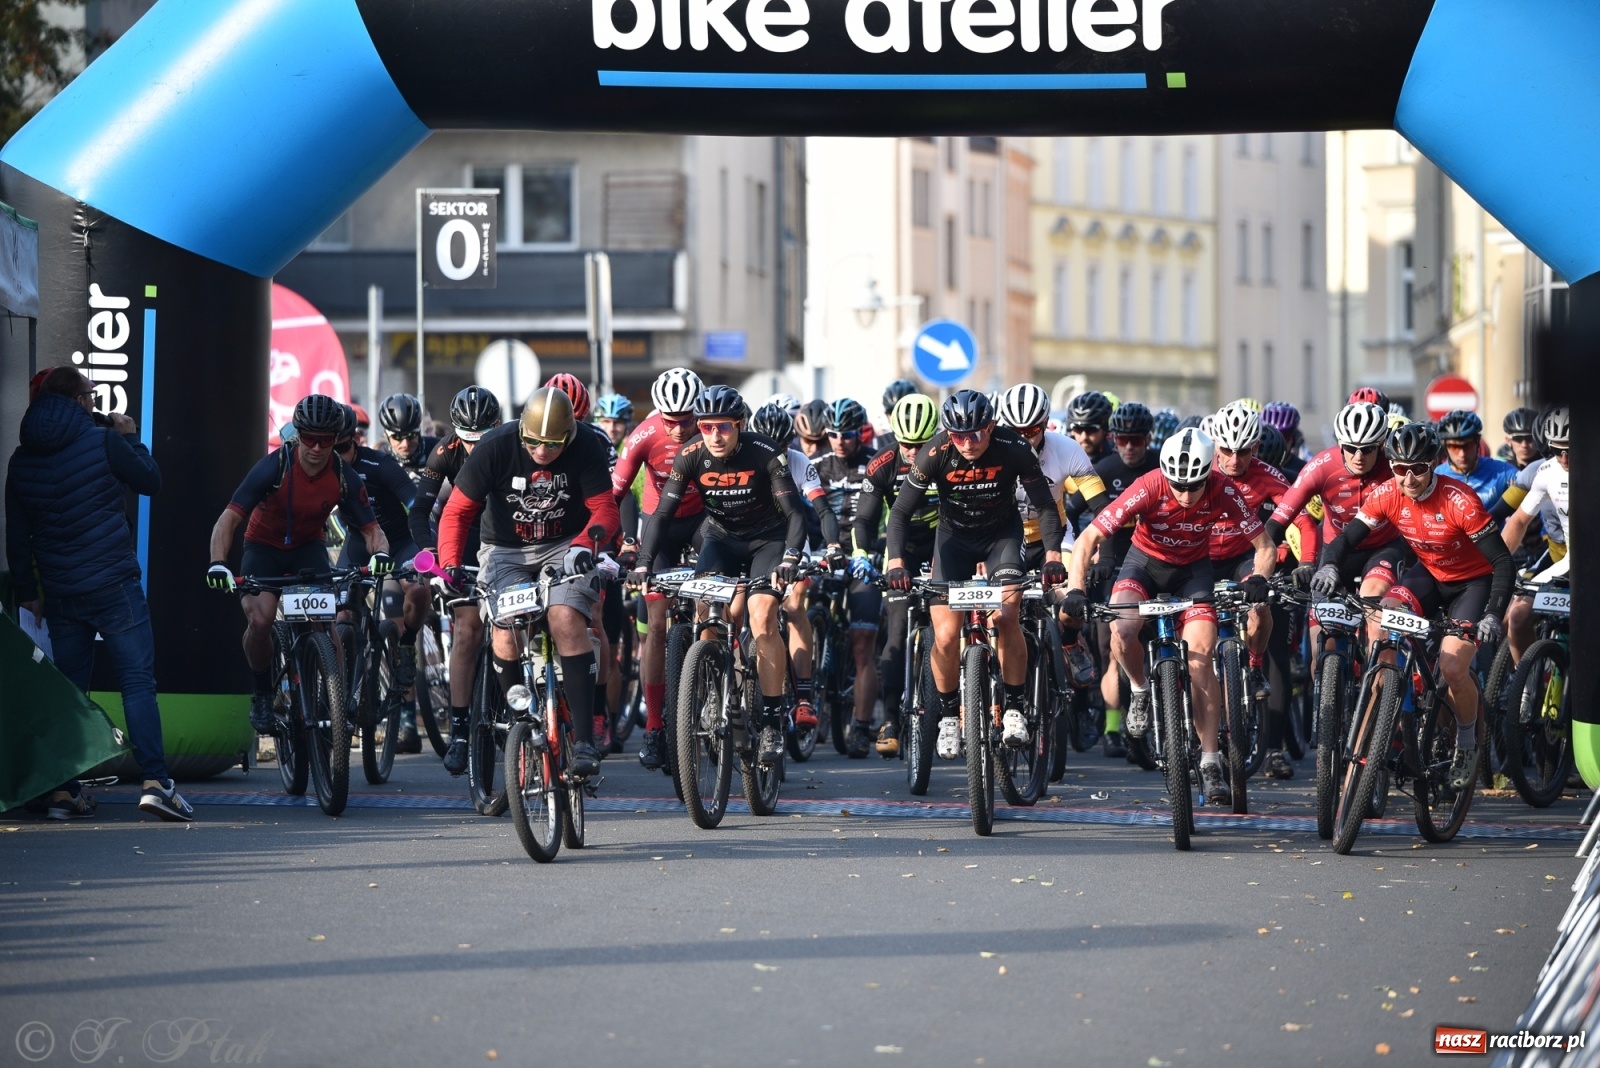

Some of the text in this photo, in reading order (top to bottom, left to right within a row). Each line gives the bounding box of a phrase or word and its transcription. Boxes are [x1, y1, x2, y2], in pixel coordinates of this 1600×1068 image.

[592, 0, 810, 52] bike
[428, 201, 488, 216] SEKTOR
[435, 218, 481, 281] 0
[629, 425, 656, 450] JBG2
[681, 440, 704, 457] CST
[1304, 452, 1331, 477] JBG2
[700, 470, 755, 487] CST
[946, 465, 1003, 482] CST
[1123, 488, 1147, 511] JBG2
[691, 581, 726, 593] 1527
[958, 590, 993, 601] 2389
[293, 597, 328, 610] 1006
[498, 591, 535, 608] 1184
[1387, 613, 1423, 630] 2831
